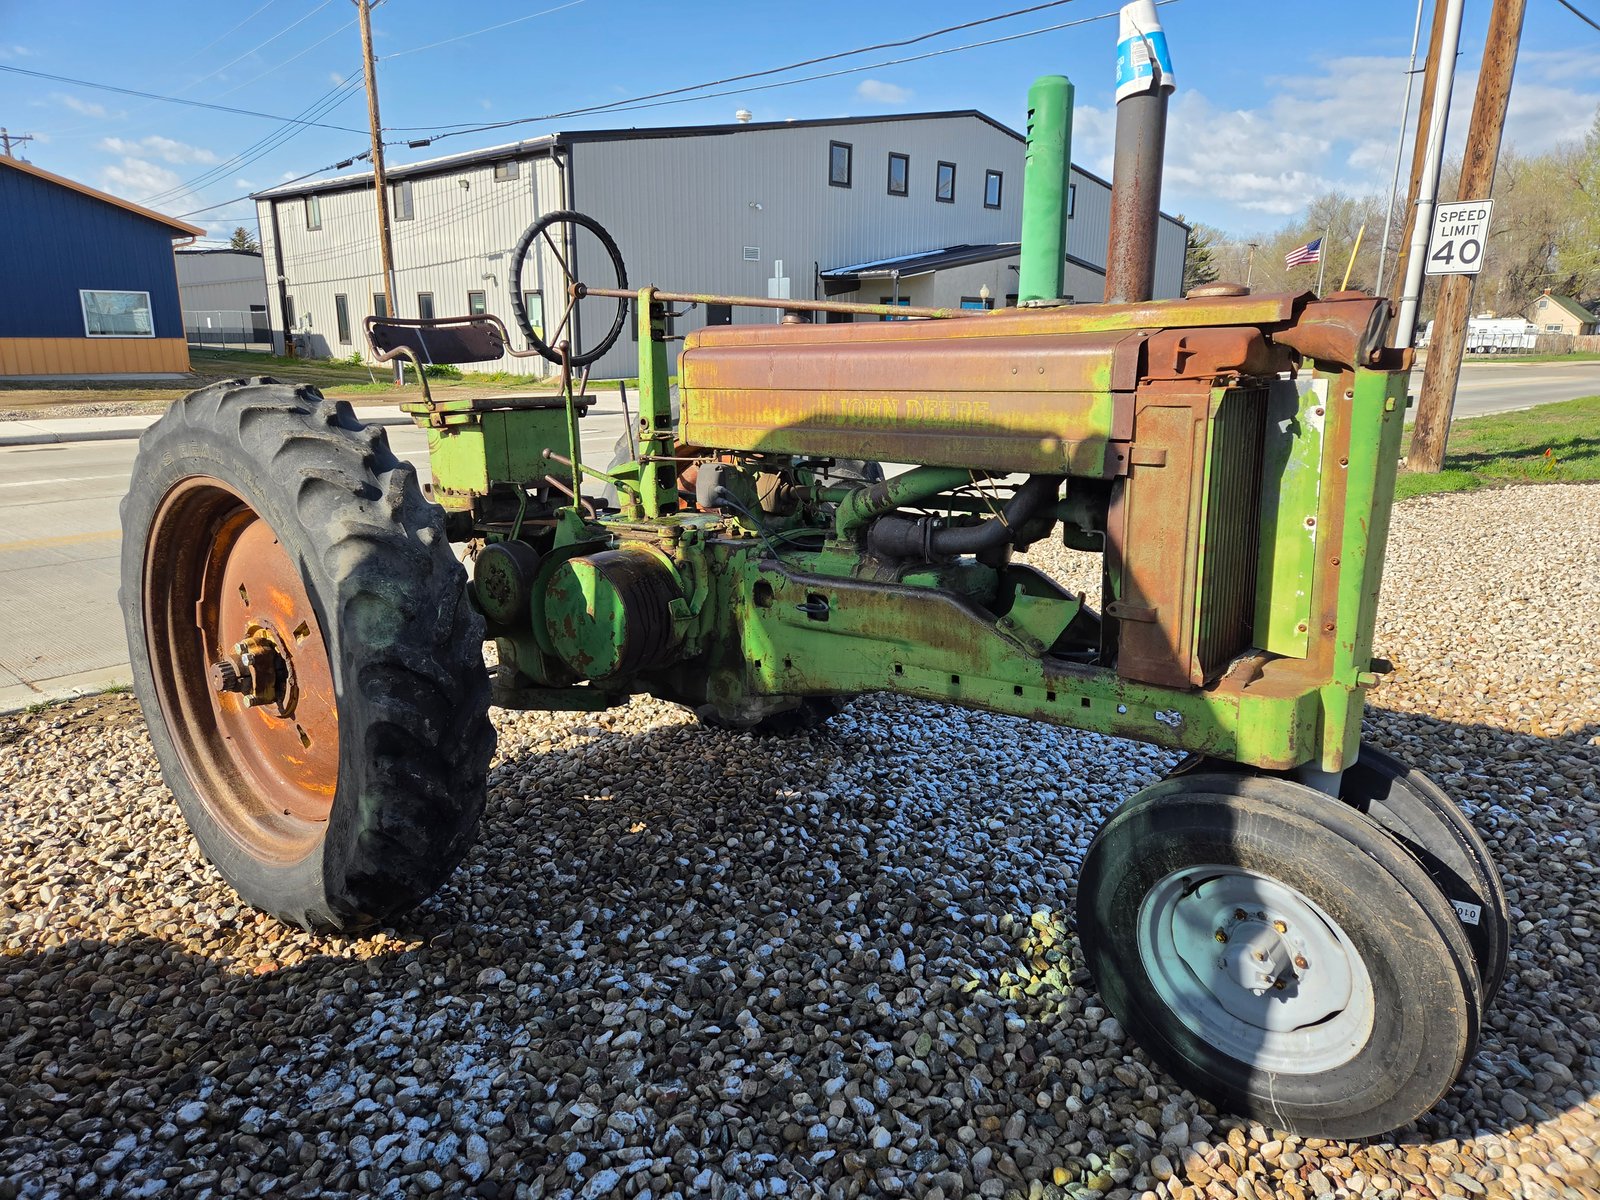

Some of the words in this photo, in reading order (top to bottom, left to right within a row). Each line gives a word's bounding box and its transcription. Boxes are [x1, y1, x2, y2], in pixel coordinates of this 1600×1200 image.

[1439, 209, 1487, 223] SPEED
[1441, 224, 1479, 237] LIMIT
[1432, 238, 1481, 265] 40
[836, 398, 899, 424] JOHN
[905, 399, 991, 427] DEERE
